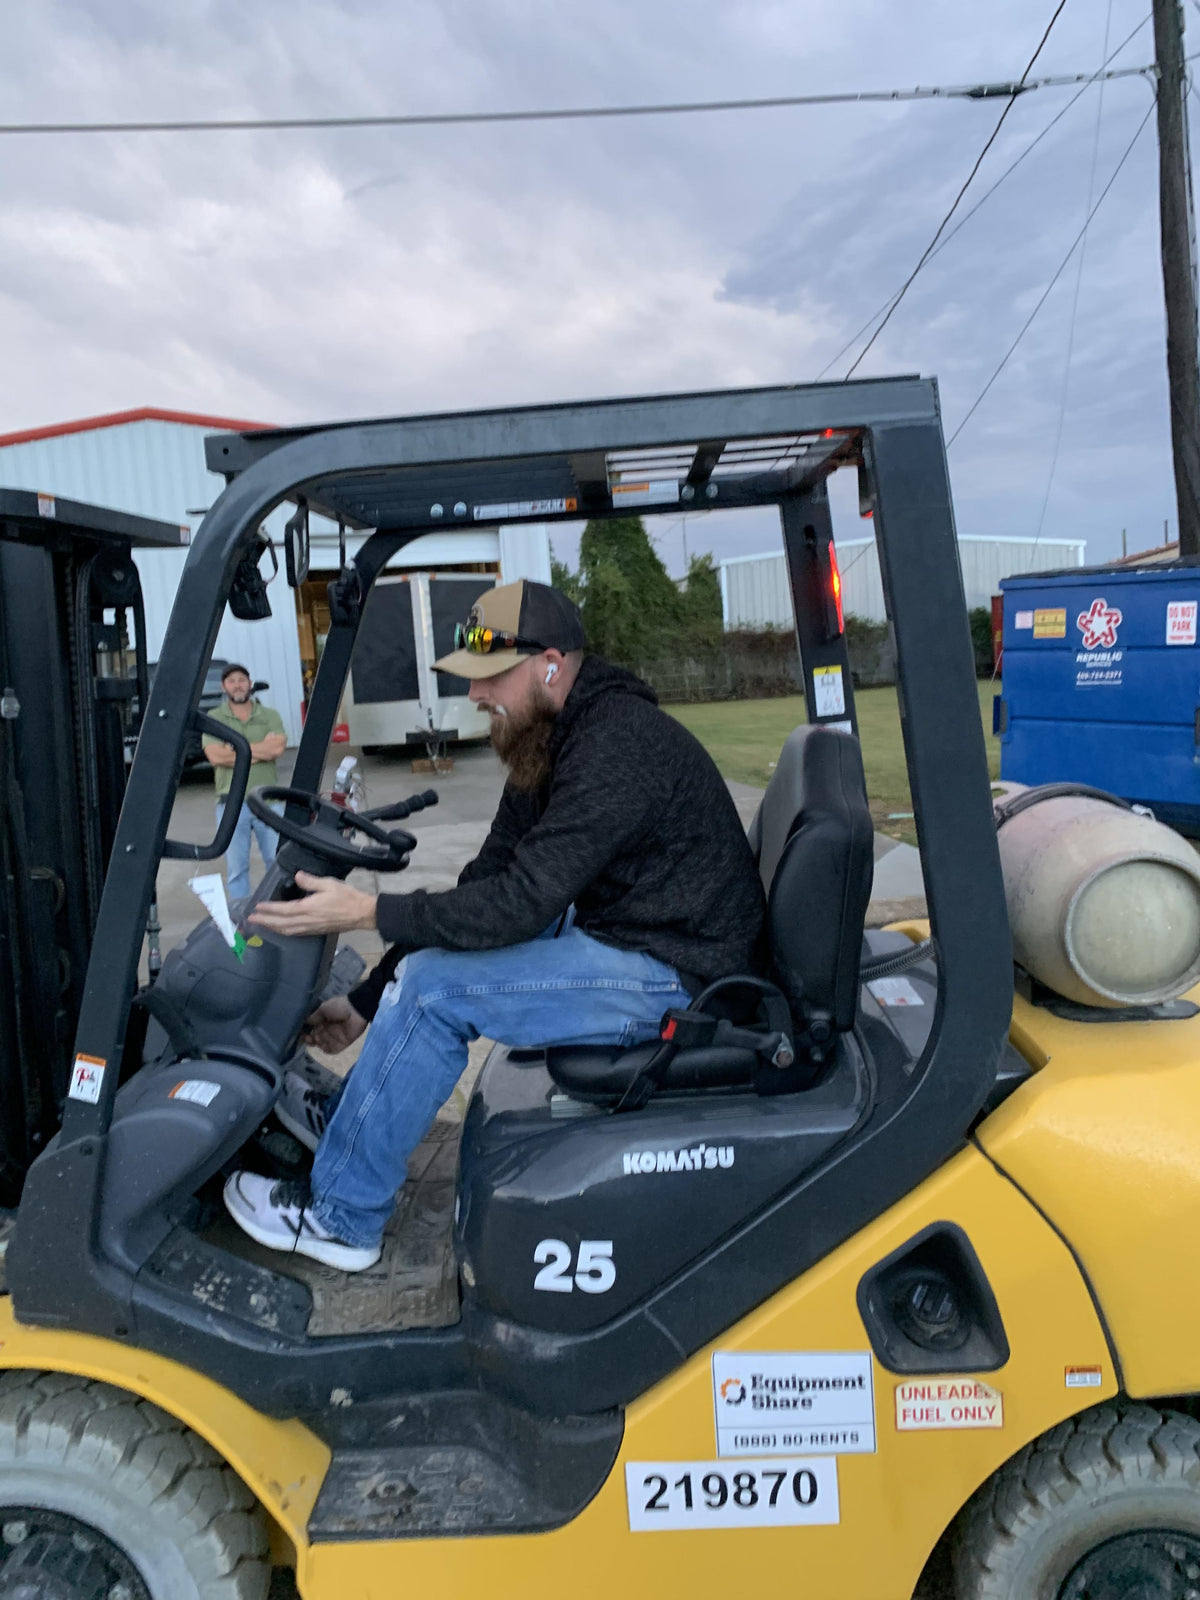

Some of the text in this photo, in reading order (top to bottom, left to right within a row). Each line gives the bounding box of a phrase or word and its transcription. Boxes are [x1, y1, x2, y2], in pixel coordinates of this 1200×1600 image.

[1169, 605, 1195, 618] DO NOT
[1172, 620, 1191, 631] PARK
[1076, 651, 1123, 663] REPUBLIC
[623, 1144, 735, 1175] KOMATSU
[533, 1239, 616, 1294] 25
[751, 1373, 866, 1394] Equipment
[751, 1394, 813, 1411] Share
[902, 1404, 996, 1422] FUEL ONLY
[643, 1469, 818, 1512] 219870
